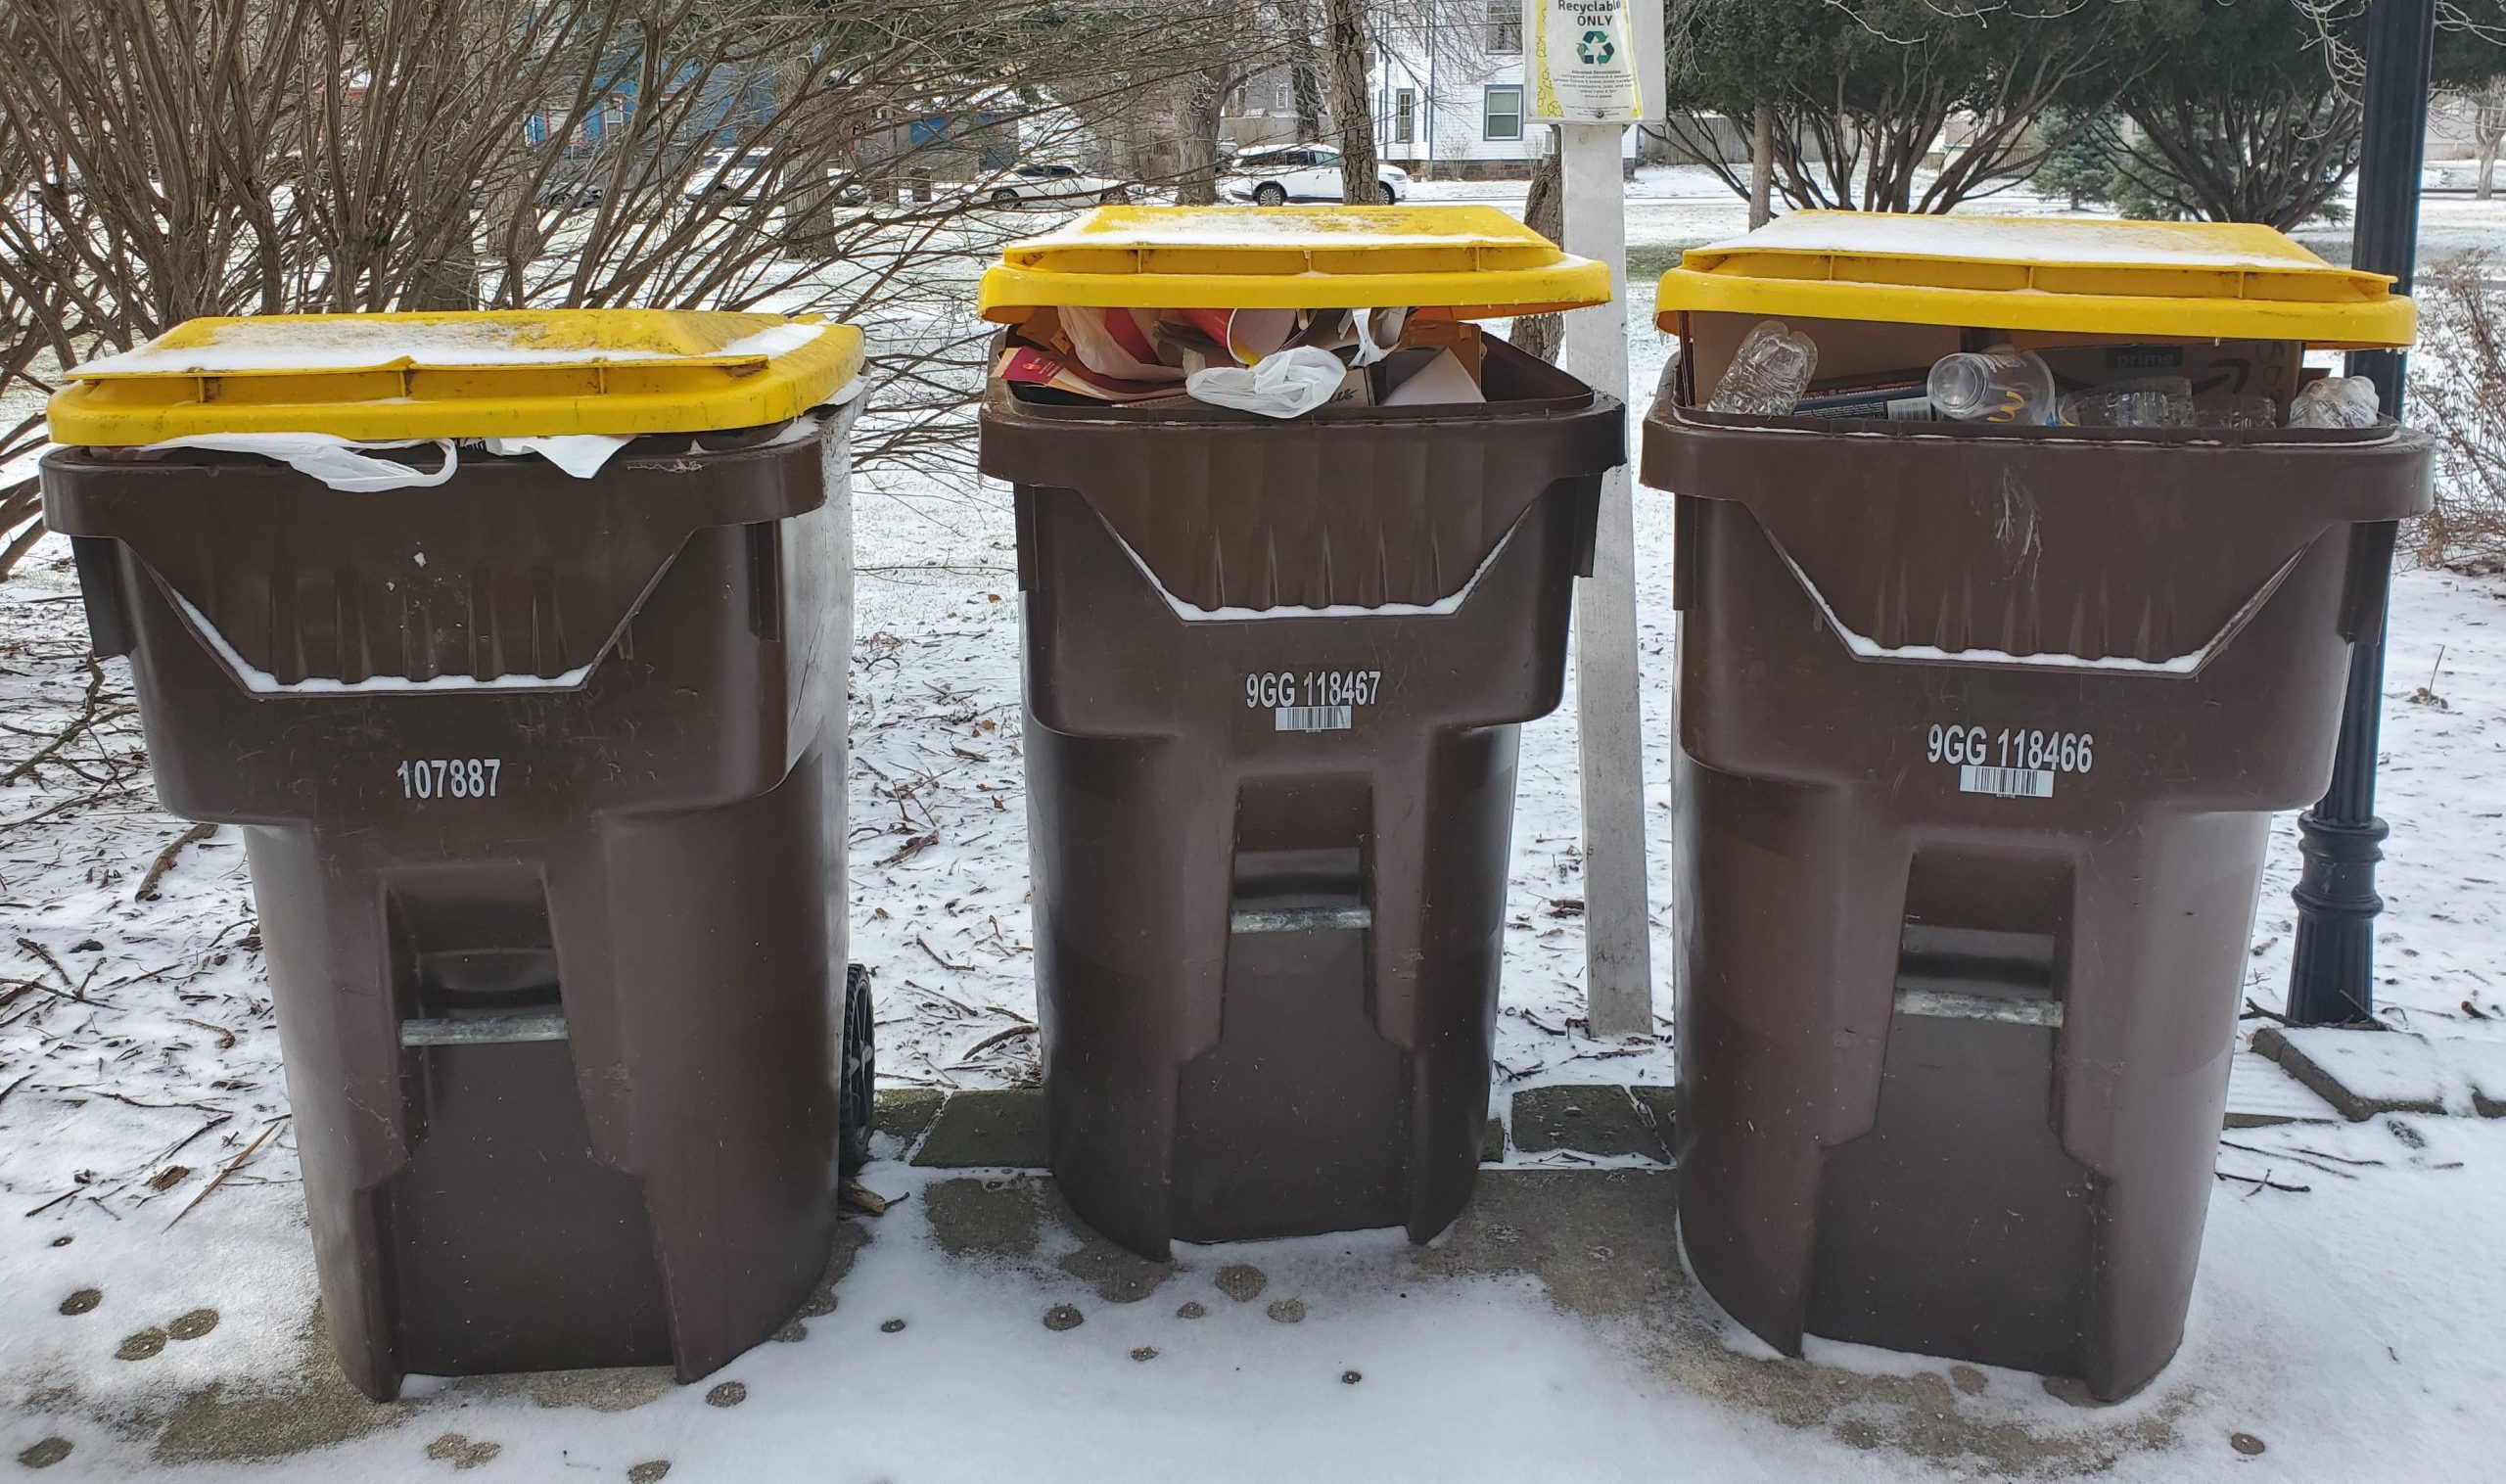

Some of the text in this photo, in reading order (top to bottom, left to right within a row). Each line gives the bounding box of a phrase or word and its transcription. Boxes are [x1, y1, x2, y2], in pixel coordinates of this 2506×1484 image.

[1577, 15, 1613, 26] ONLY
[2117, 351, 2175, 368] prime
[1246, 671, 1381, 708] 9GG 118467
[1926, 723, 2094, 773] 9GG 118466
[395, 759, 501, 799] 107887
